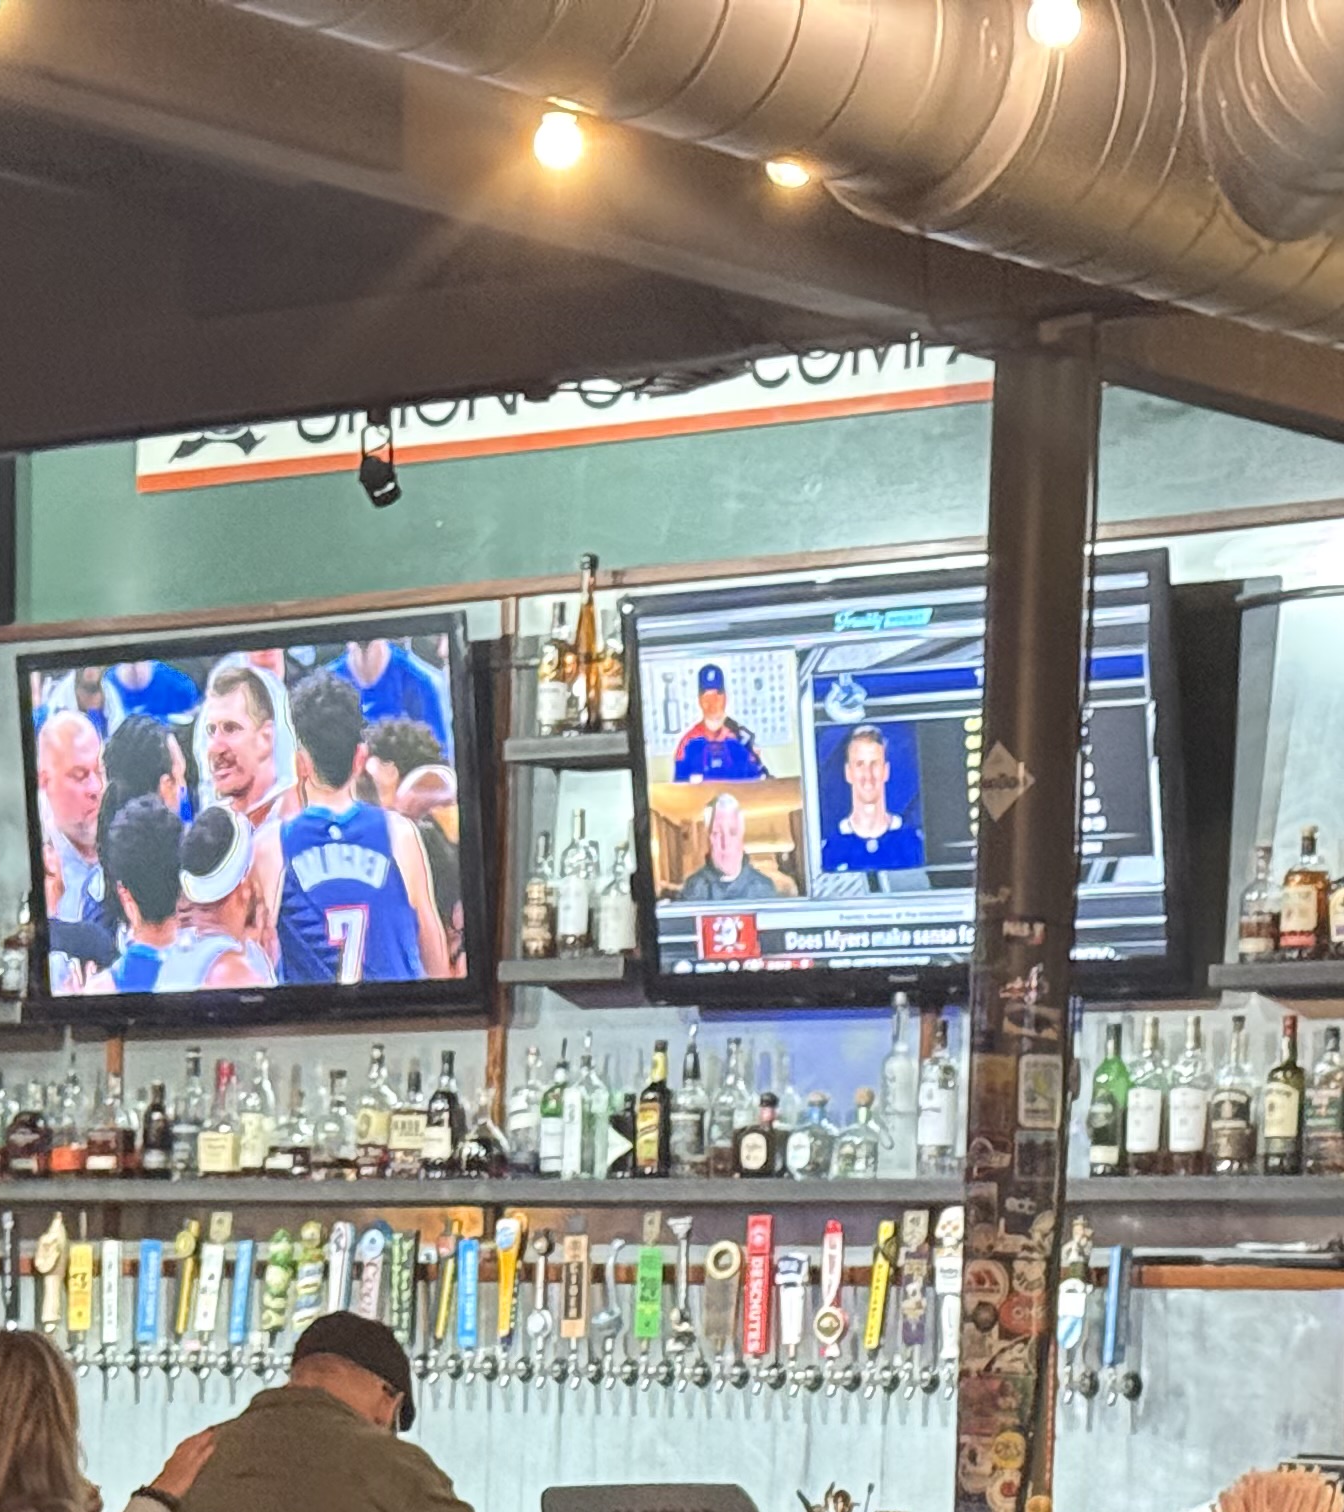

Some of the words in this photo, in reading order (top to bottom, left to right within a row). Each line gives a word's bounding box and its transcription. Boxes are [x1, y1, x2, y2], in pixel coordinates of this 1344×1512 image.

[325, 904, 370, 985] 7
[785, 930, 822, 951] Does
[824, 929, 870, 952] Myers
[746, 1257, 766, 1354] DESCHUTES
